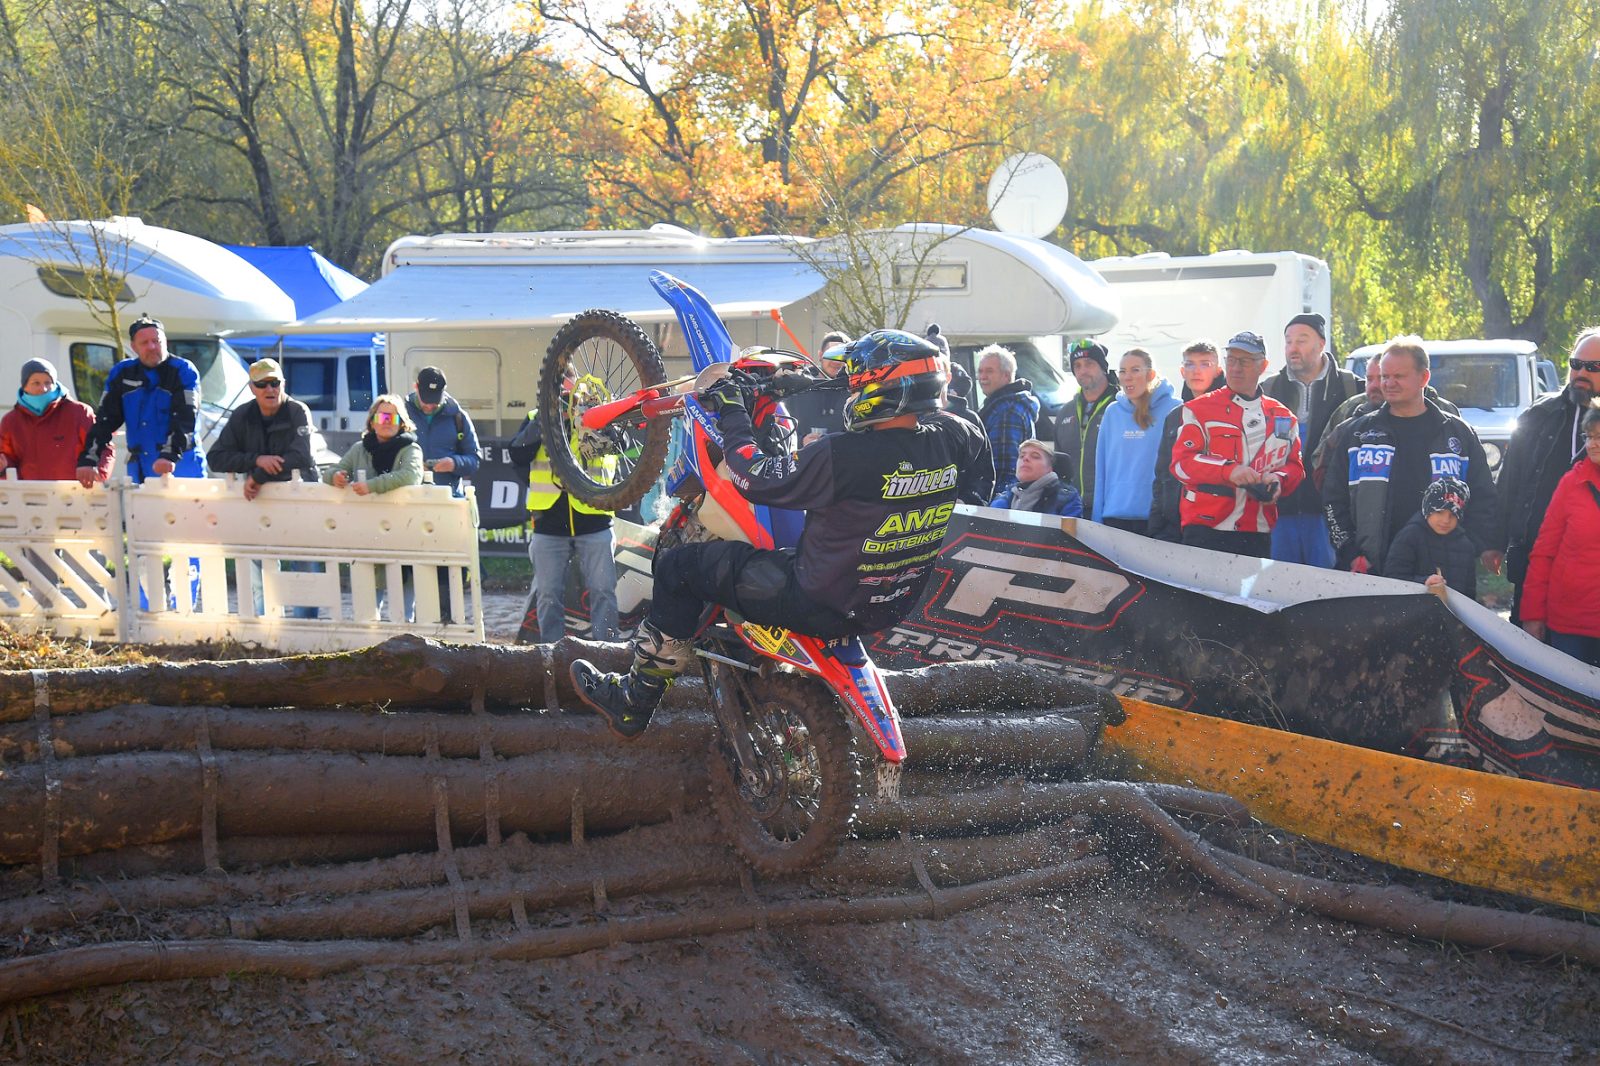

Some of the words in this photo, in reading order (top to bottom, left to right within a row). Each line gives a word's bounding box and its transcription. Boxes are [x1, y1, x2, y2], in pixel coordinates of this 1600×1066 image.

[1357, 450, 1394, 466] FAST
[876, 502, 955, 537] AMS
[863, 526, 948, 553] DIRTBIKES
[886, 626, 1185, 702] PRIP
